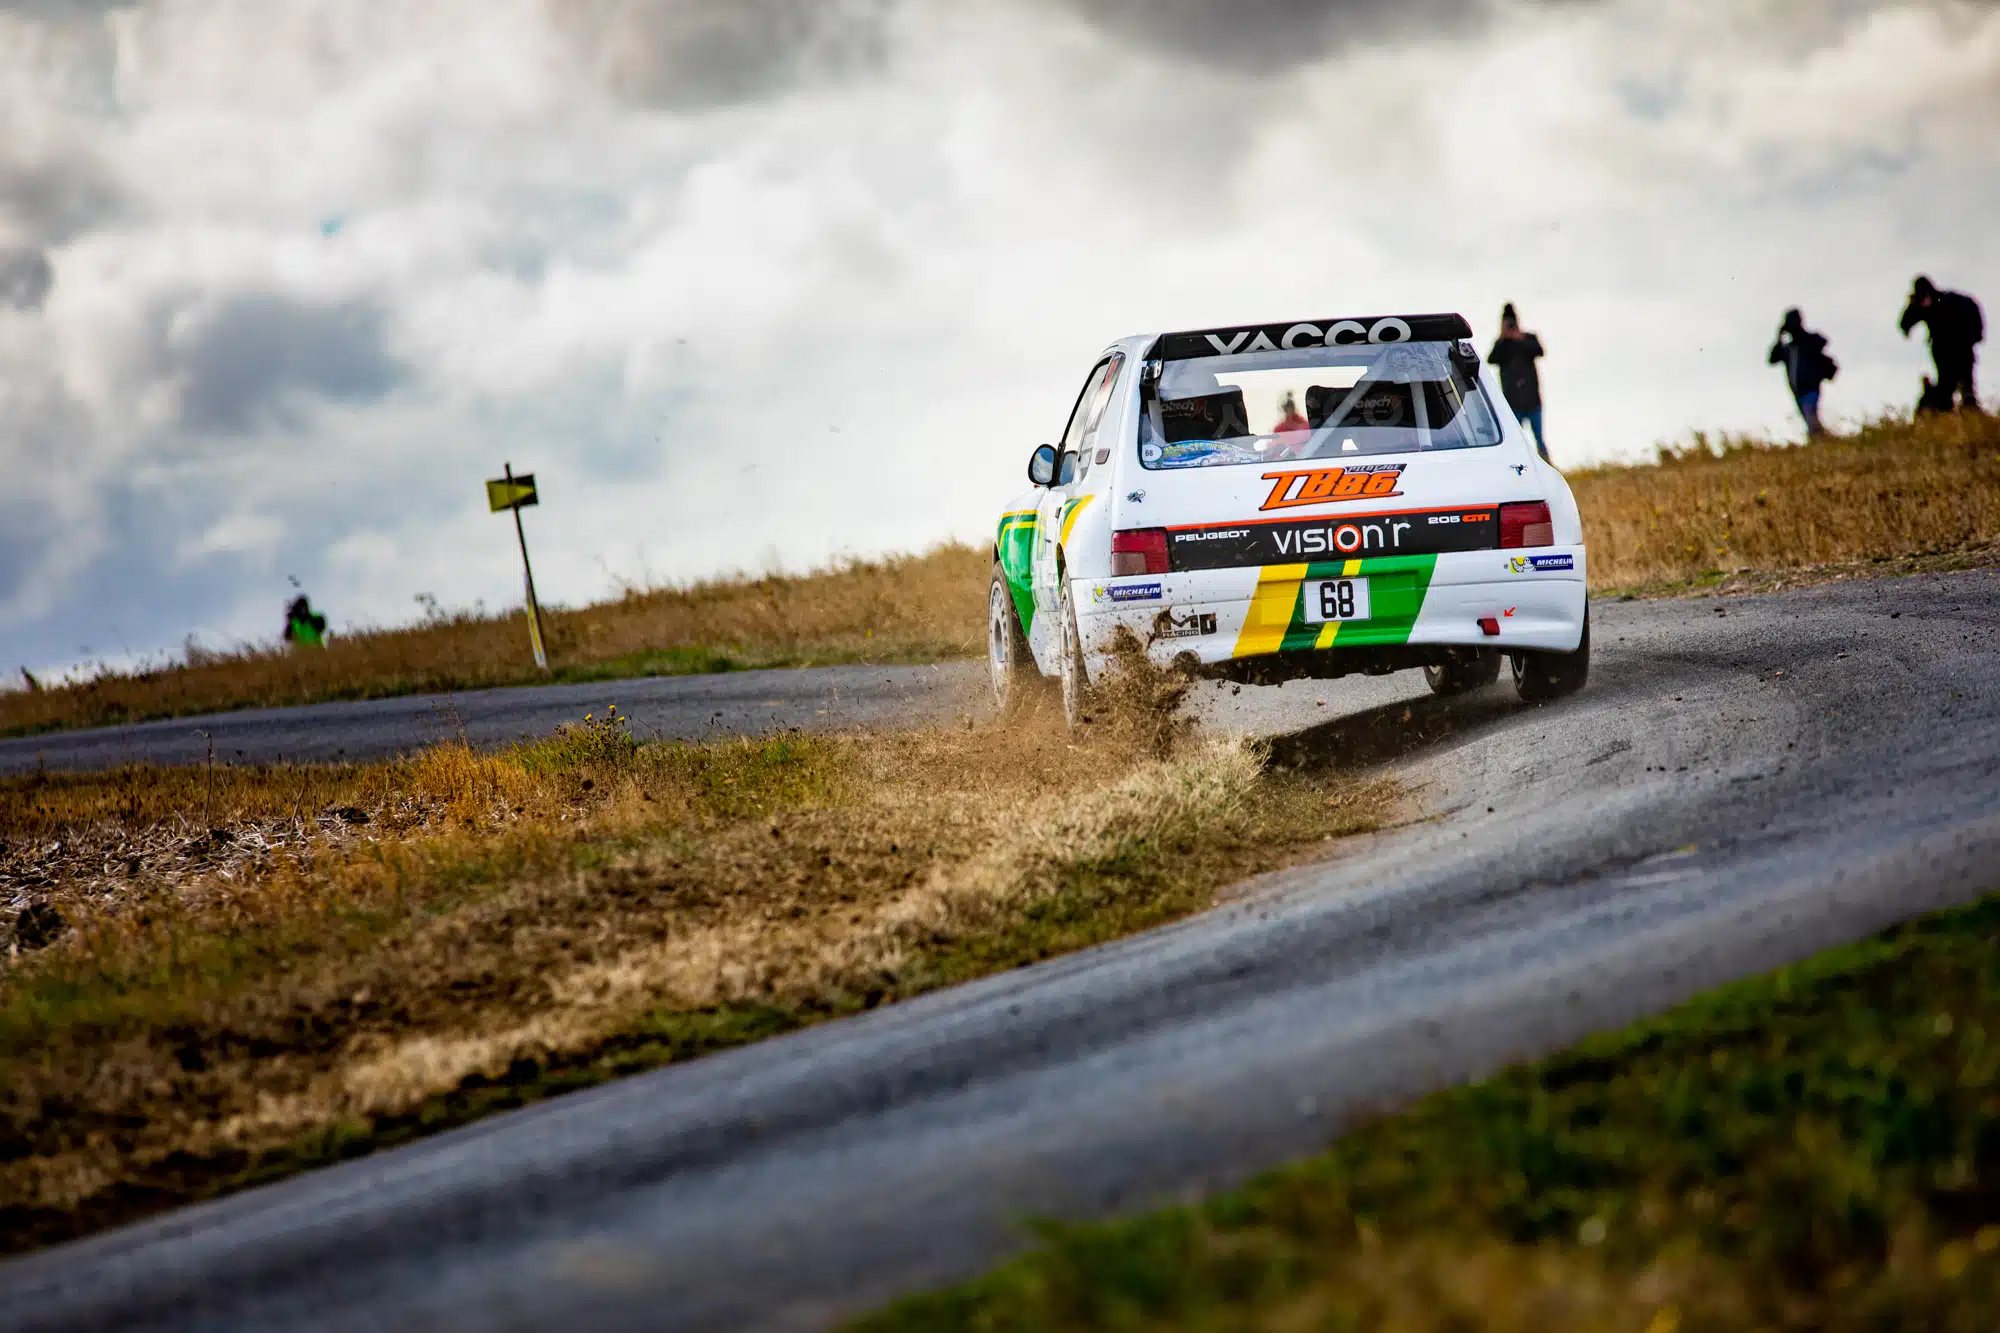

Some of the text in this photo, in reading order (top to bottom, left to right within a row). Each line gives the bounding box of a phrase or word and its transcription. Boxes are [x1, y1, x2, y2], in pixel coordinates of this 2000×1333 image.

[1203, 317, 1412, 355] YACCO
[1144, 449, 1154, 457] 68
[1258, 468, 1405, 511] TB86
[1428, 513, 1491, 524] 205 GTI
[1175, 529, 1250, 543] PEUGEOT
[1536, 558, 1573, 566] MICHELIN
[1113, 587, 1160, 596] MICHELIN
[1320, 580, 1355, 619] 68
